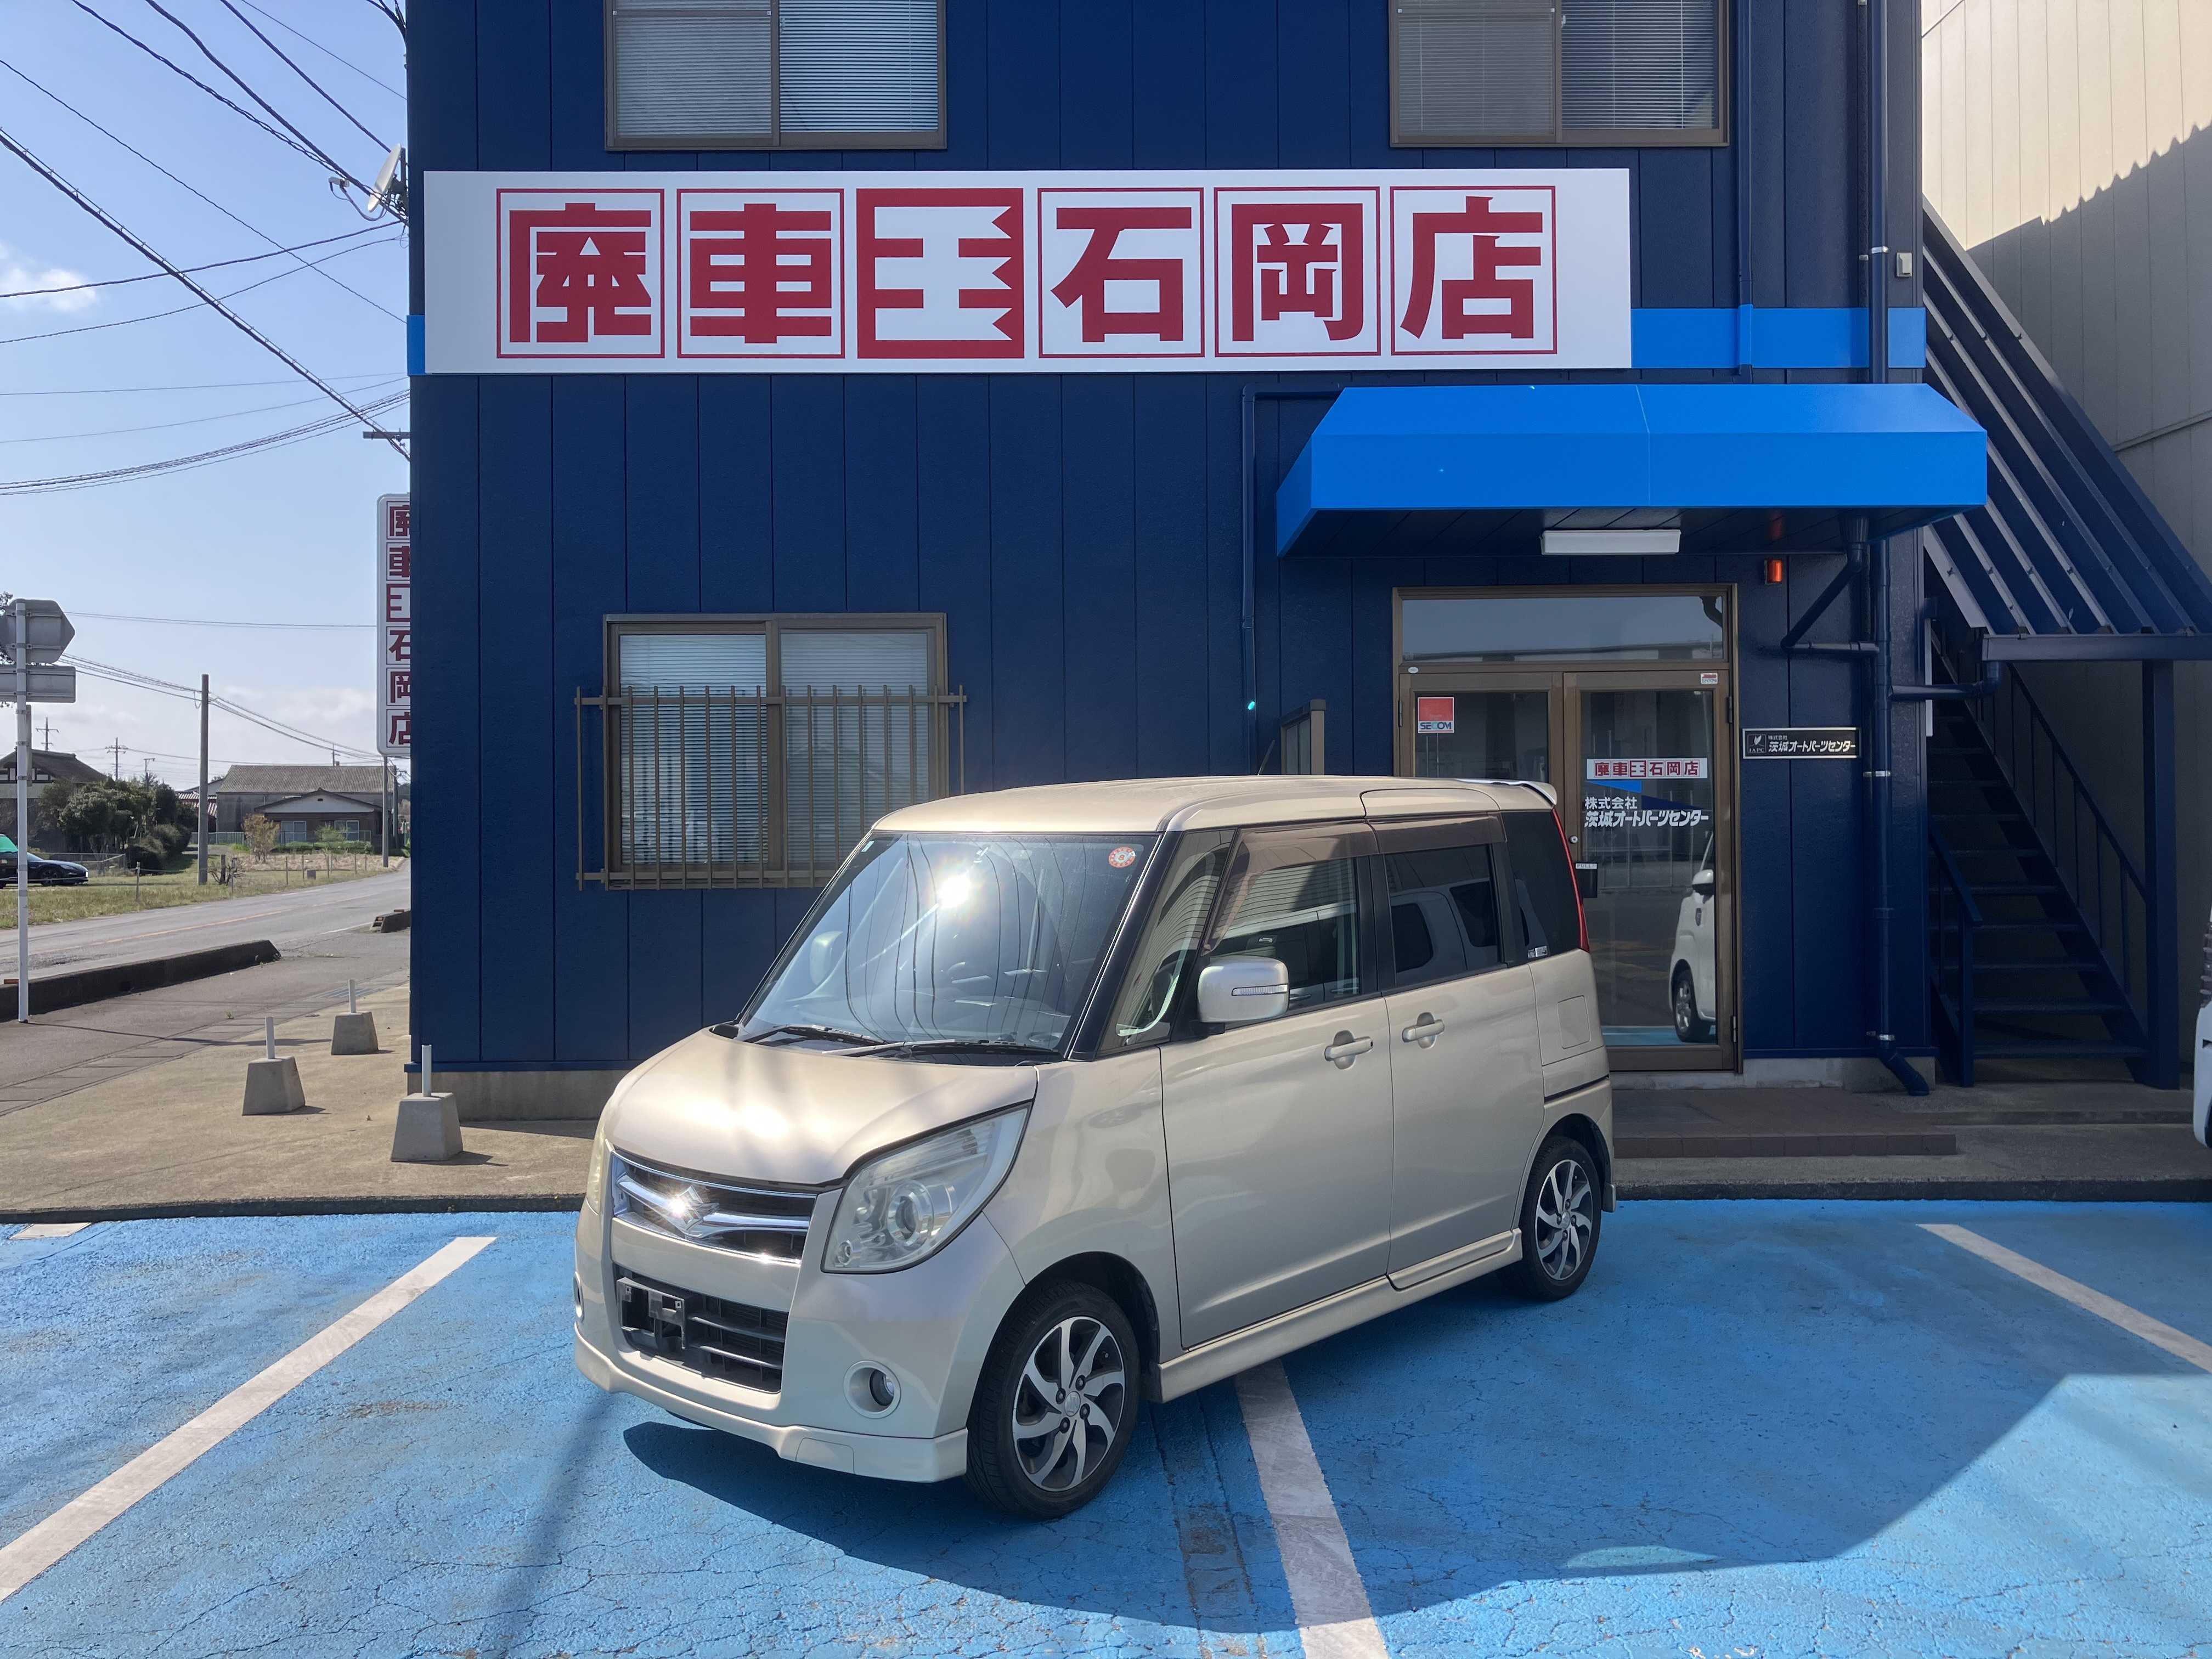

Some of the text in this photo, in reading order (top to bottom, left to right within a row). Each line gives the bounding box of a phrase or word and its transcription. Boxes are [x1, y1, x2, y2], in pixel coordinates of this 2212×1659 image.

[508, 187, 1545, 360] 廃車王石岡店
[1420, 721, 1452, 730] SECOM
[1768, 741, 1856, 752] 茨城オートパーツセンター
[1584, 797, 1638, 810] 株式会社
[1584, 810, 1709, 827] 茨城オートパーツセンター
